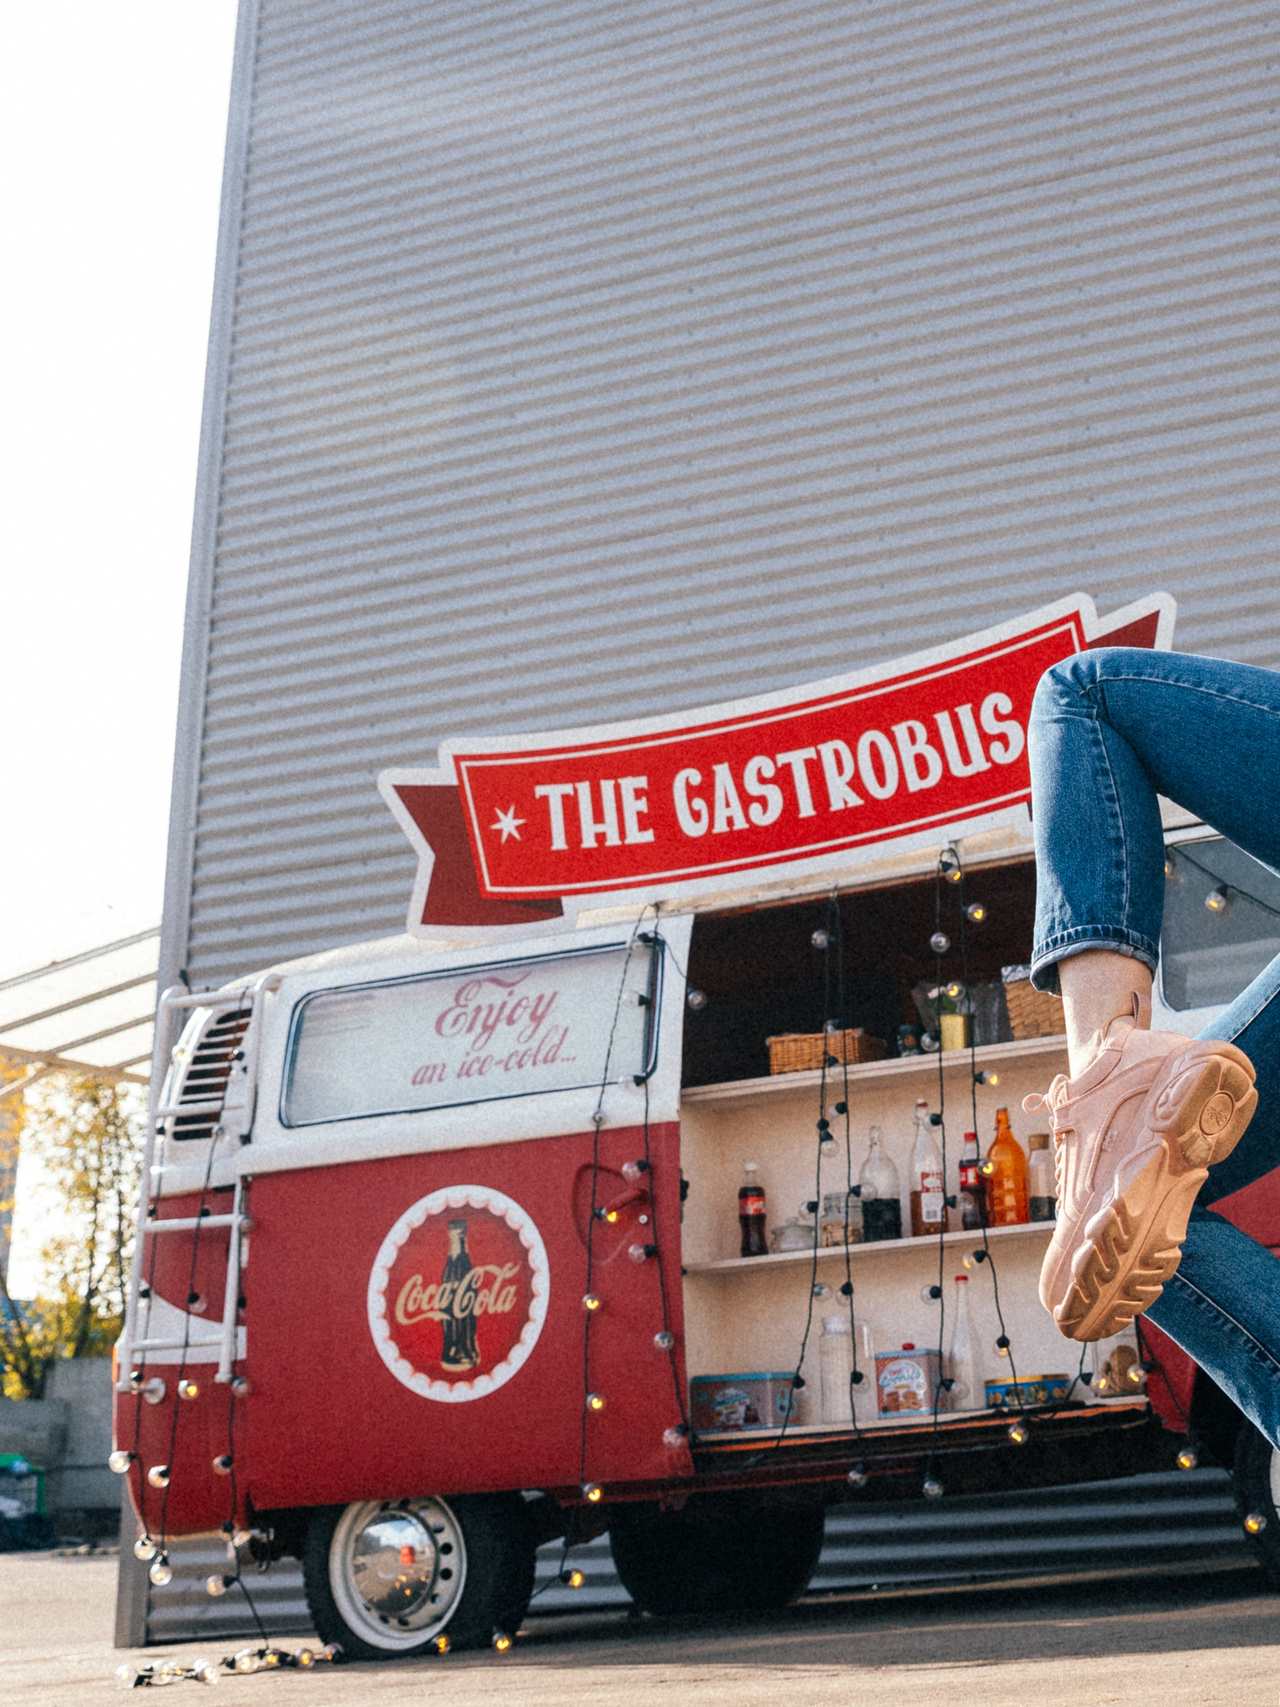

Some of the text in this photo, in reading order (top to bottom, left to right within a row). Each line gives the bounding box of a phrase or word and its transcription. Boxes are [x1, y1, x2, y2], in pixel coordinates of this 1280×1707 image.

[534, 691, 1027, 852] THE GASTROBUS
[433, 970, 559, 1051] Enjoy
[411, 1026, 577, 1086] an ice-cold...
[394, 1260, 522, 1326] Coca-Cola
